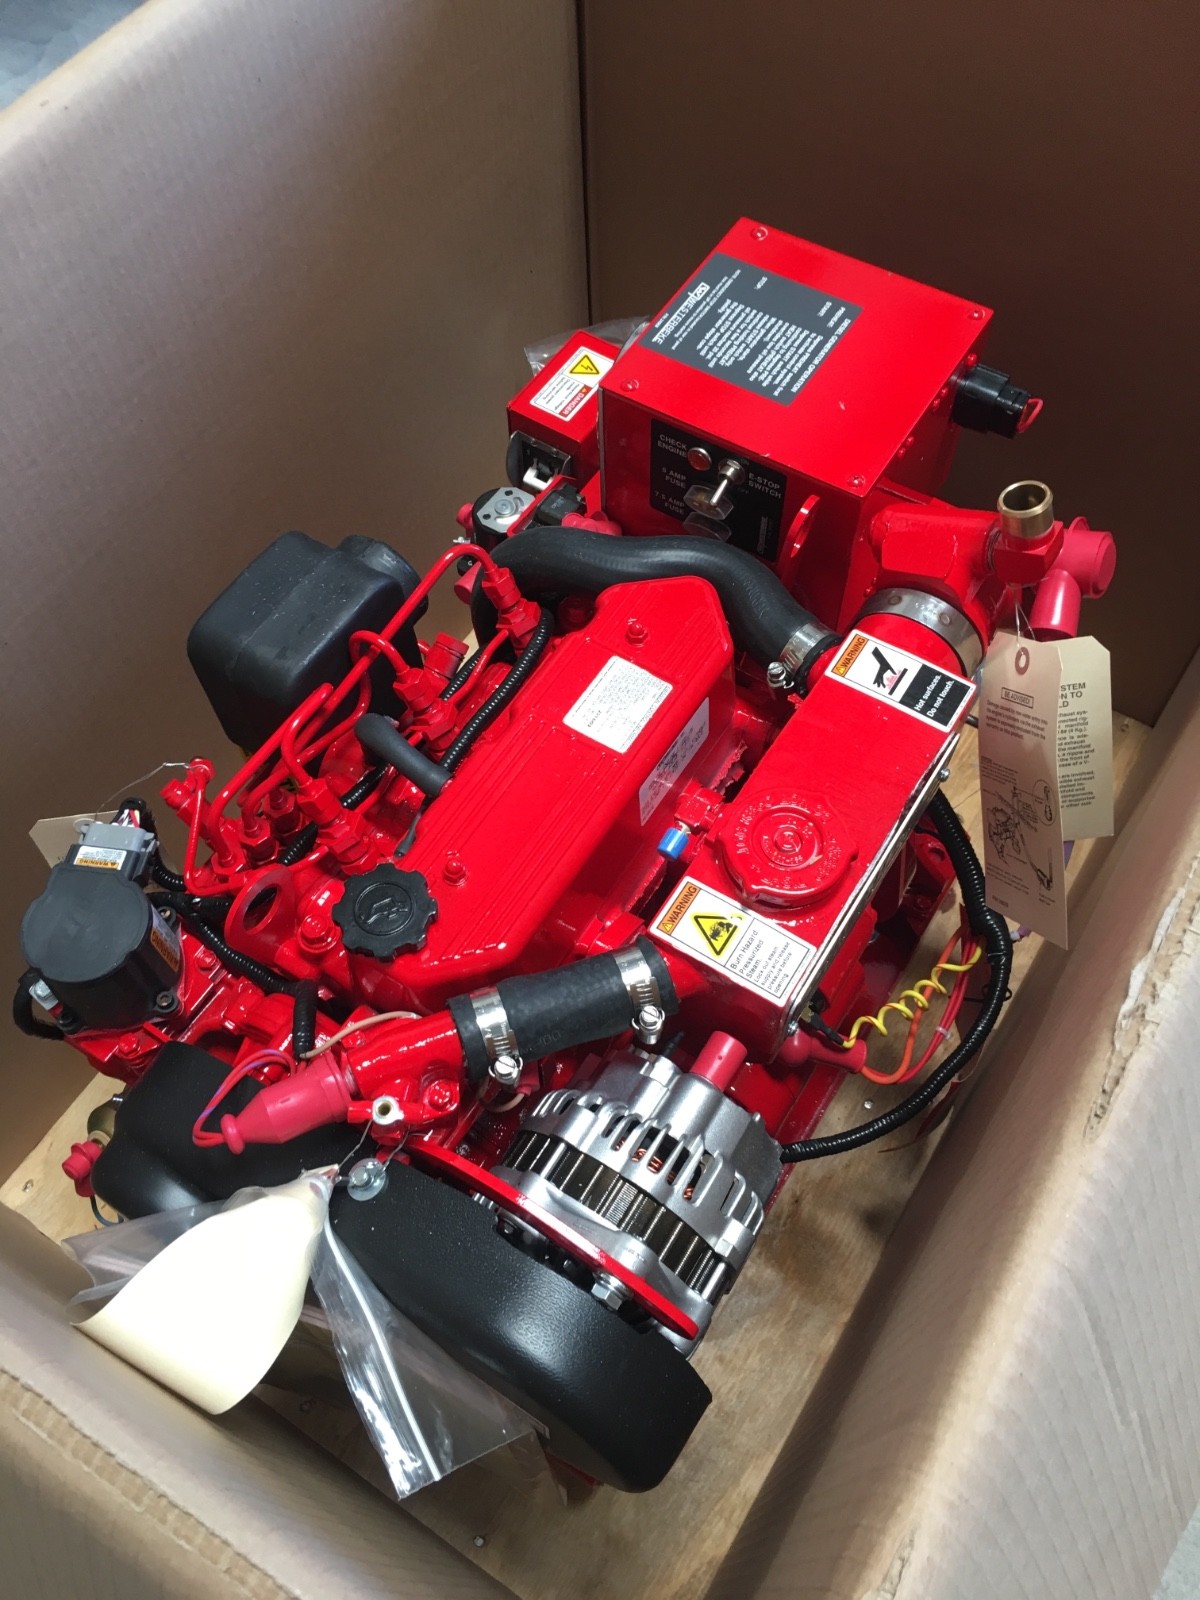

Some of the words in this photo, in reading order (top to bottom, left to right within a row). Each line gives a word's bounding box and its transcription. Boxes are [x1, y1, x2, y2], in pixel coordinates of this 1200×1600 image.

[652, 298, 699, 345] WESTERBEKE
[834, 318, 850, 334] DIESEL
[812, 335, 837, 364] GENERATOR
[791, 364, 815, 392] OPERATION
[562, 392, 584, 415] DANGER
[657, 440, 687, 458] ENGINE
[659, 434, 687, 450] CHECK
[665, 475, 686, 489] FUSE
[748, 472, 780, 490] E-STOP
[748, 480, 782, 499] SWITCH
[664, 502, 685, 515] FUSE
[841, 637, 865, 668] WARNING
[913, 699, 925, 710] Hot
[922, 675, 941, 699] surfaces.
[926, 707, 936, 717] Do
[933, 696, 943, 708] not
[939, 680, 954, 697] touch.
[1070, 690, 1082, 698] TO
[668, 885, 697, 924] WARNING
[729, 953, 743, 969] Burn
[738, 939, 763, 974] Pressurized
